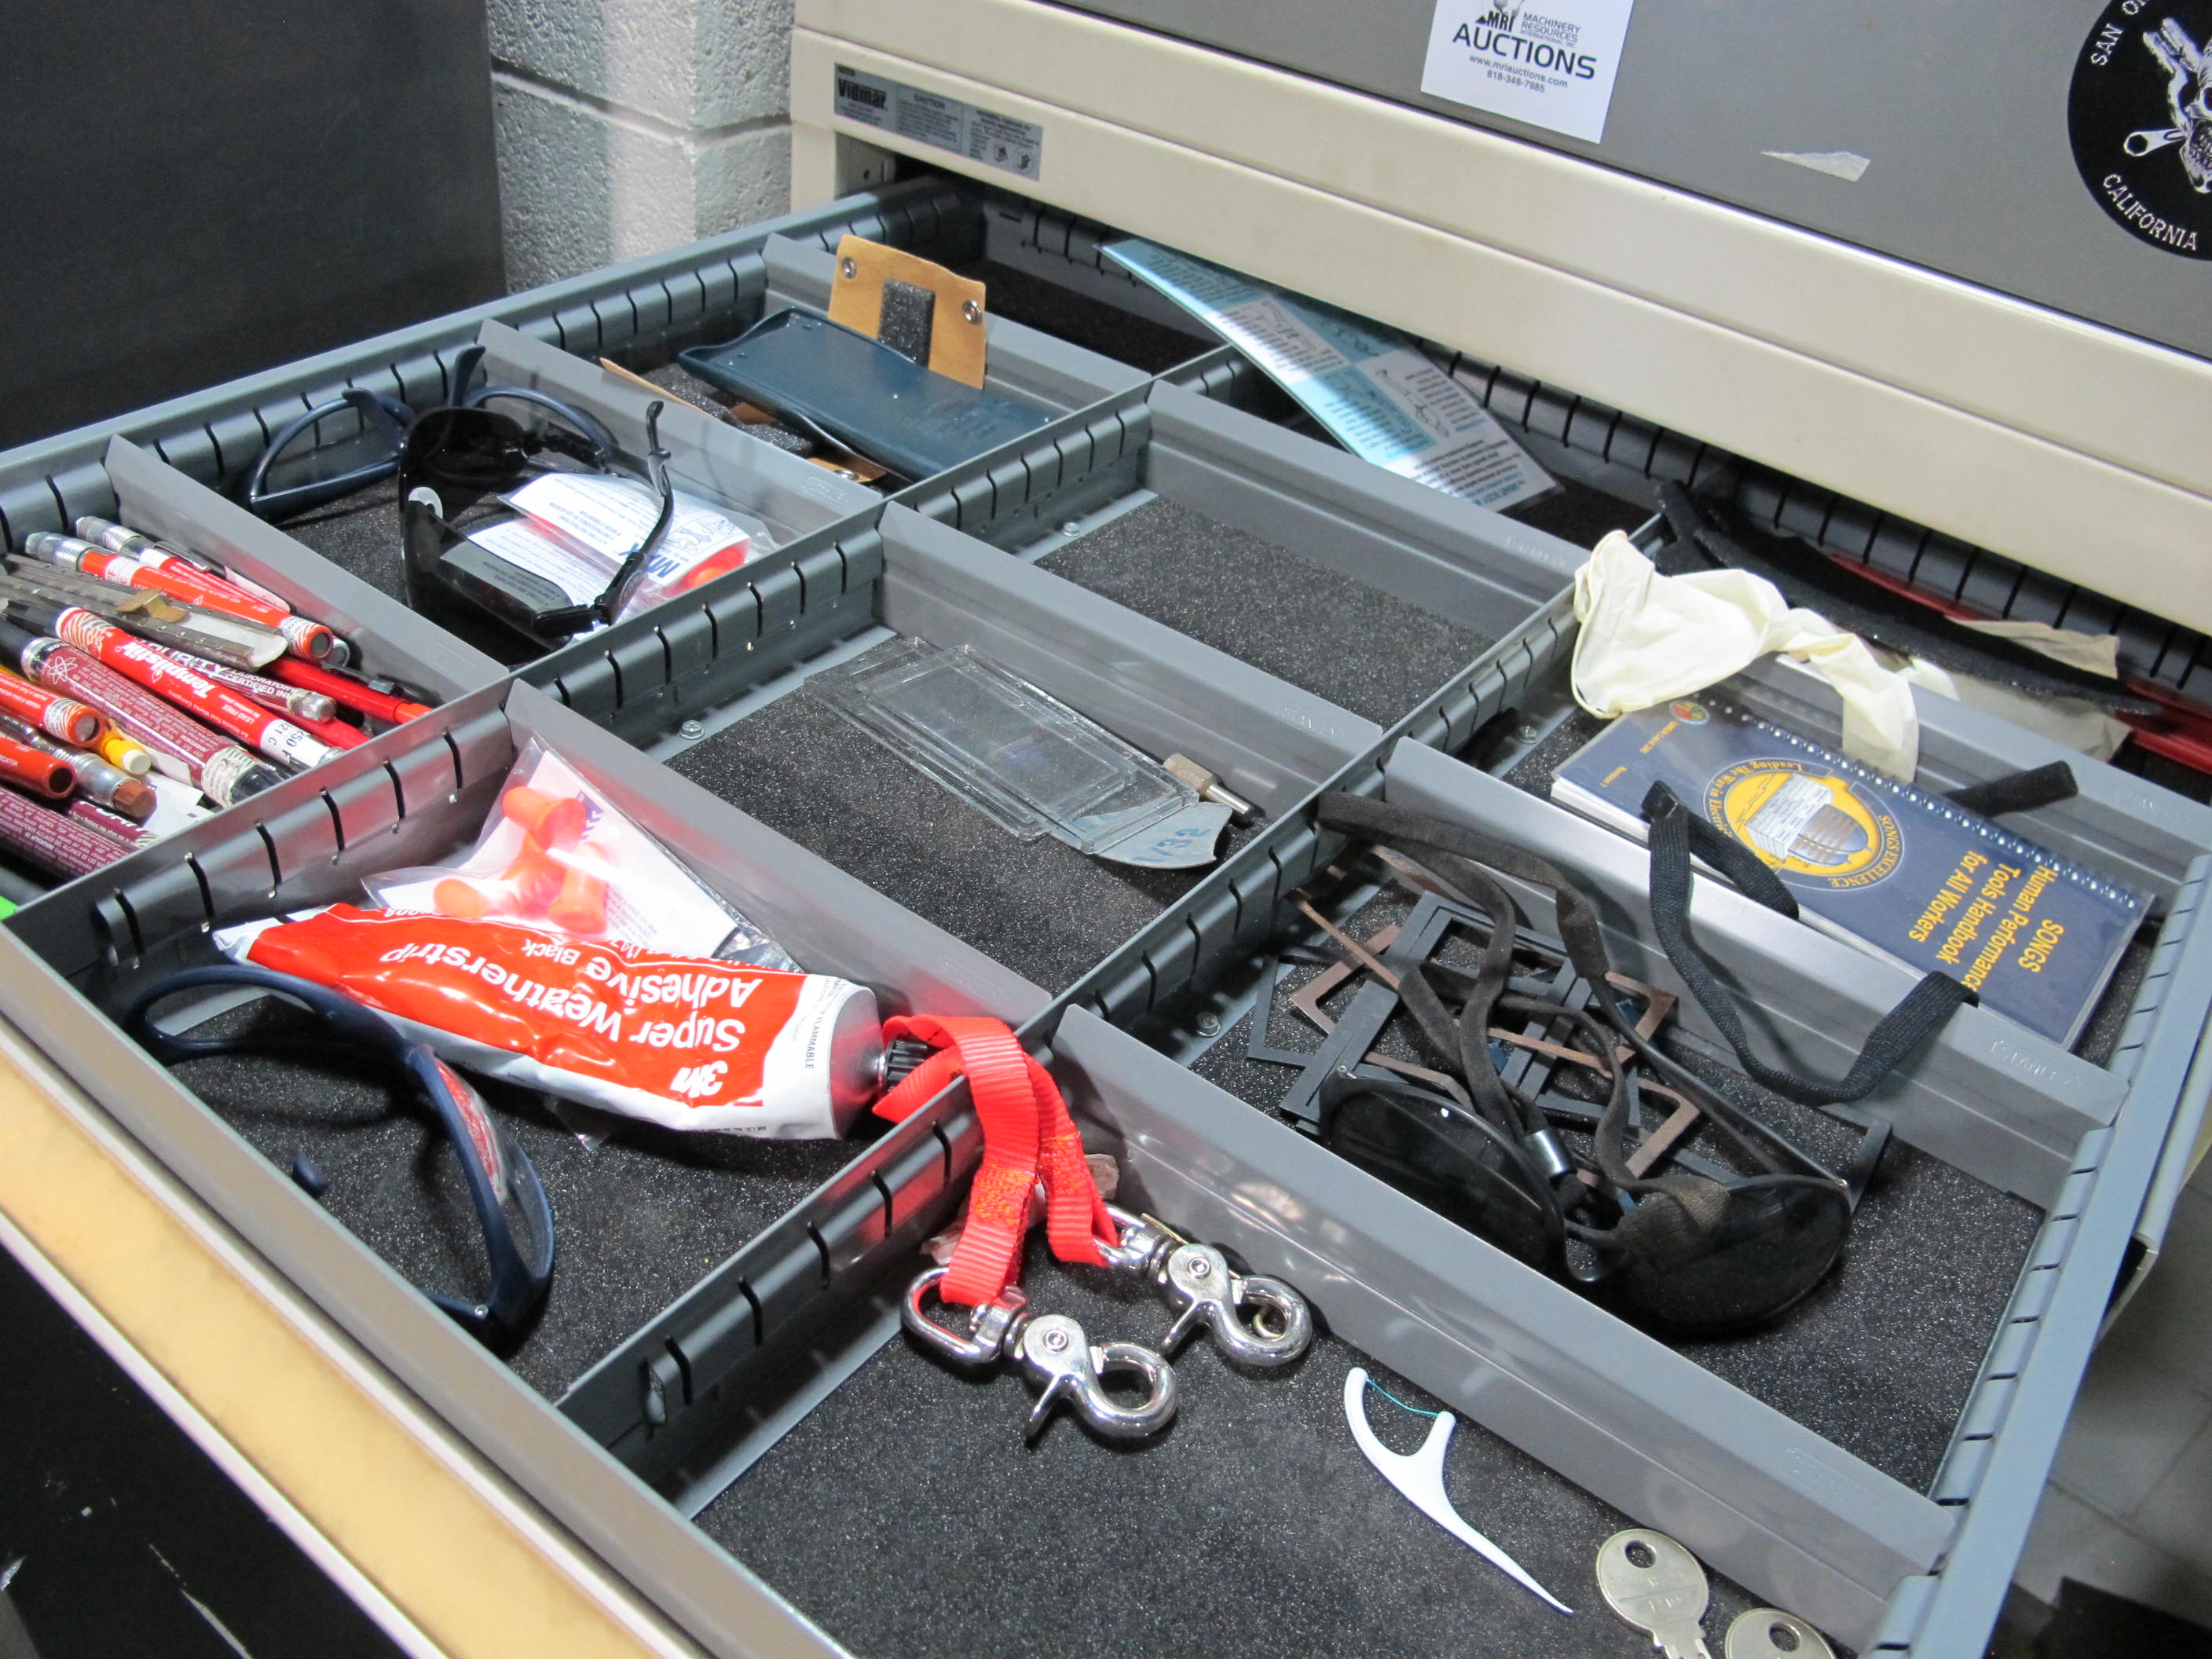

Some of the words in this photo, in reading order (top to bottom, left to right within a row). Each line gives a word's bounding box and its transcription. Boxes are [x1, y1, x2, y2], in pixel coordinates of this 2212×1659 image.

[1486, 10, 1514, 32] MRI
[1522, 13, 1581, 34] MACHINERY
[1522, 21, 1578, 42] RESOURCES
[1452, 23, 1597, 80] AUCTIONS
[2090, 23, 2123, 66] SAN
[1470, 54, 1568, 88] www.mriauctions.com
[838, 78, 888, 110] Vidmar
[2103, 174, 2198, 251] CALIFORNIA
[121, 641, 215, 698] Tempilstik
[225, 673, 276, 694] CERTIFIED
[220, 704, 239, 716] FREE
[236, 712, 255, 723] LEAD
[1712, 773, 1736, 786] Way
[1730, 764, 1751, 777] The
[1749, 760, 1804, 771] Leading
[1877, 815, 1899, 847] SONGS
[1827, 851, 1897, 888] EXCELLENCE
[1959, 849, 1990, 874] for
[1944, 869, 1974, 892] All
[1979, 862, 2021, 901] Tools
[2012, 864, 2058, 913] Human
[1906, 887, 1964, 943] Workers
[1936, 897, 1996, 967] Handbook
[523, 939, 577, 966] Black
[1959, 909, 2030, 991] Performance
[2019, 918, 2065, 974] SONGS
[380, 941, 619, 1043] Weatherstrip
[591, 957, 764, 1007] Adhesive
[629, 1016, 746, 1053] Super
[670, 1060, 726, 1097] 3M
